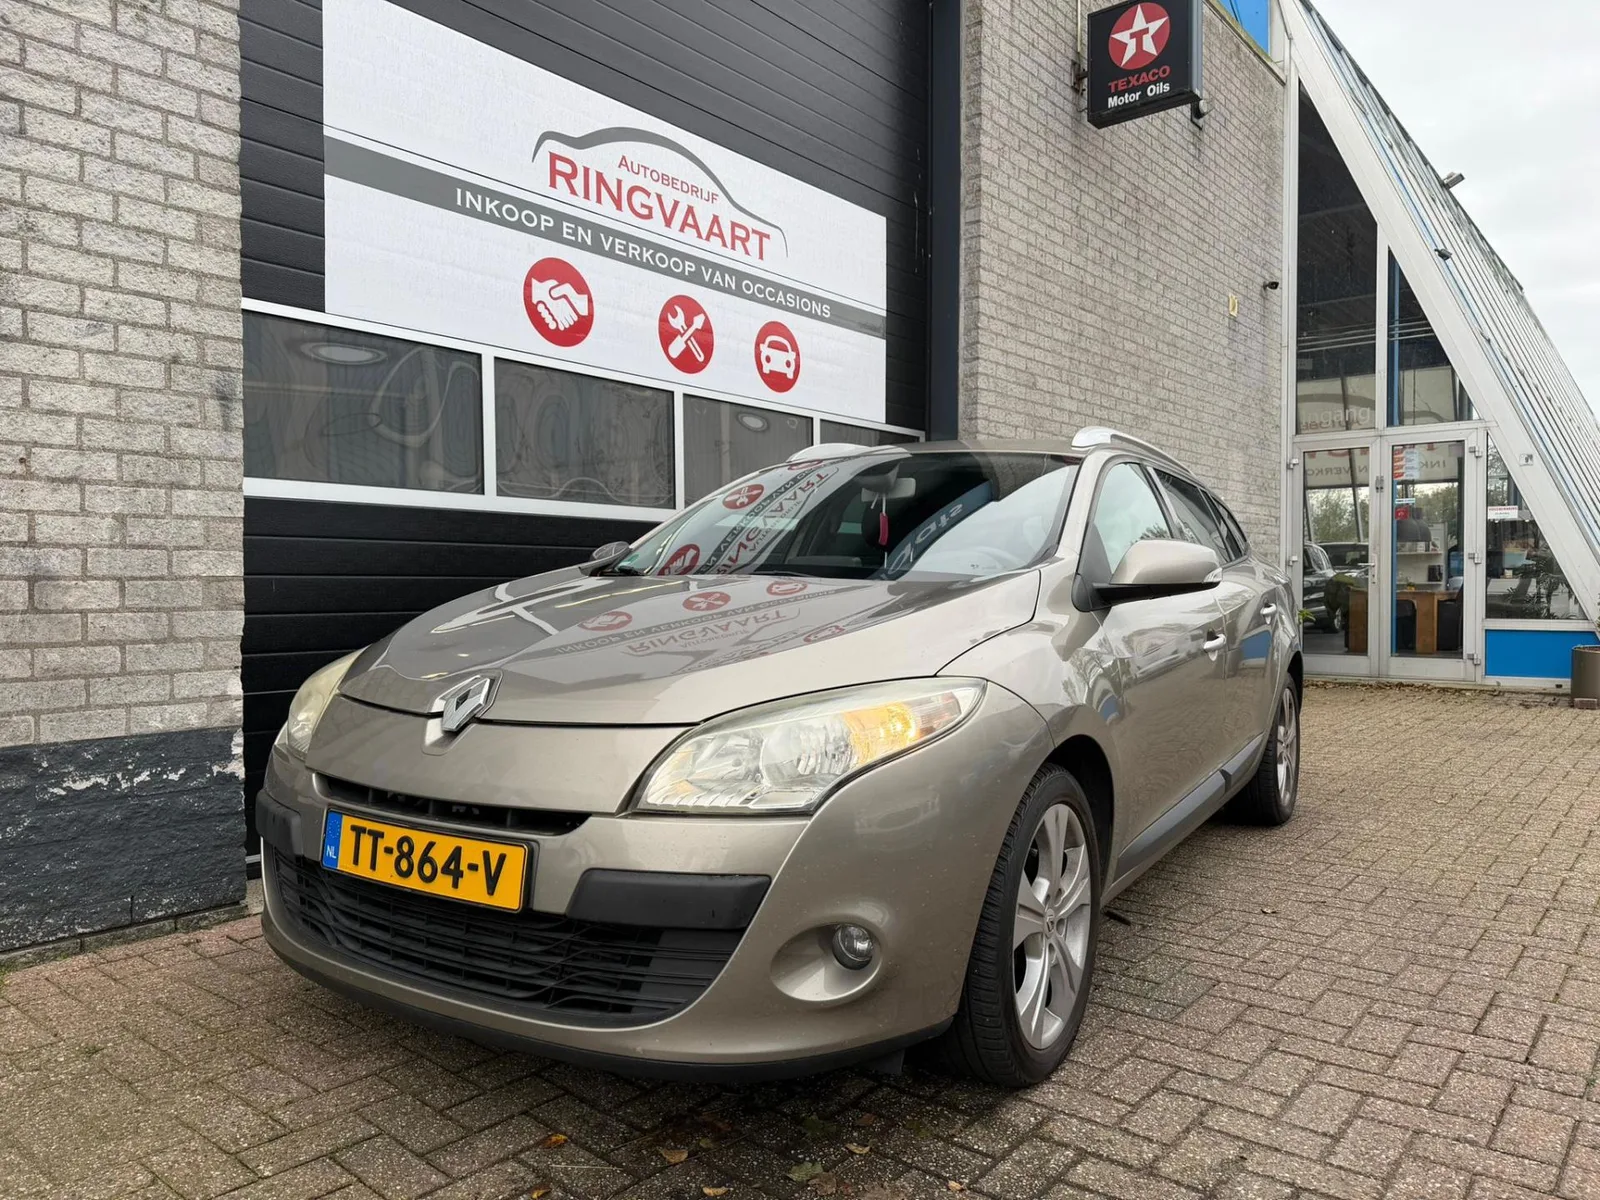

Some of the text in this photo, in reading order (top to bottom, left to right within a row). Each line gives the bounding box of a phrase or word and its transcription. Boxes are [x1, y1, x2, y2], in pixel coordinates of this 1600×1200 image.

[1108, 65, 1171, 93] TEXACO
[1108, 82, 1170, 109] Motor Oils
[617, 155, 719, 204] AUTOBEDRIJF
[548, 151, 771, 261] RINGVAART
[456, 188, 831, 318] INKOOP EN VERKOOP VAN OCCASIONS
[326, 844, 337, 859] NL
[350, 824, 507, 896] TT-864-V
